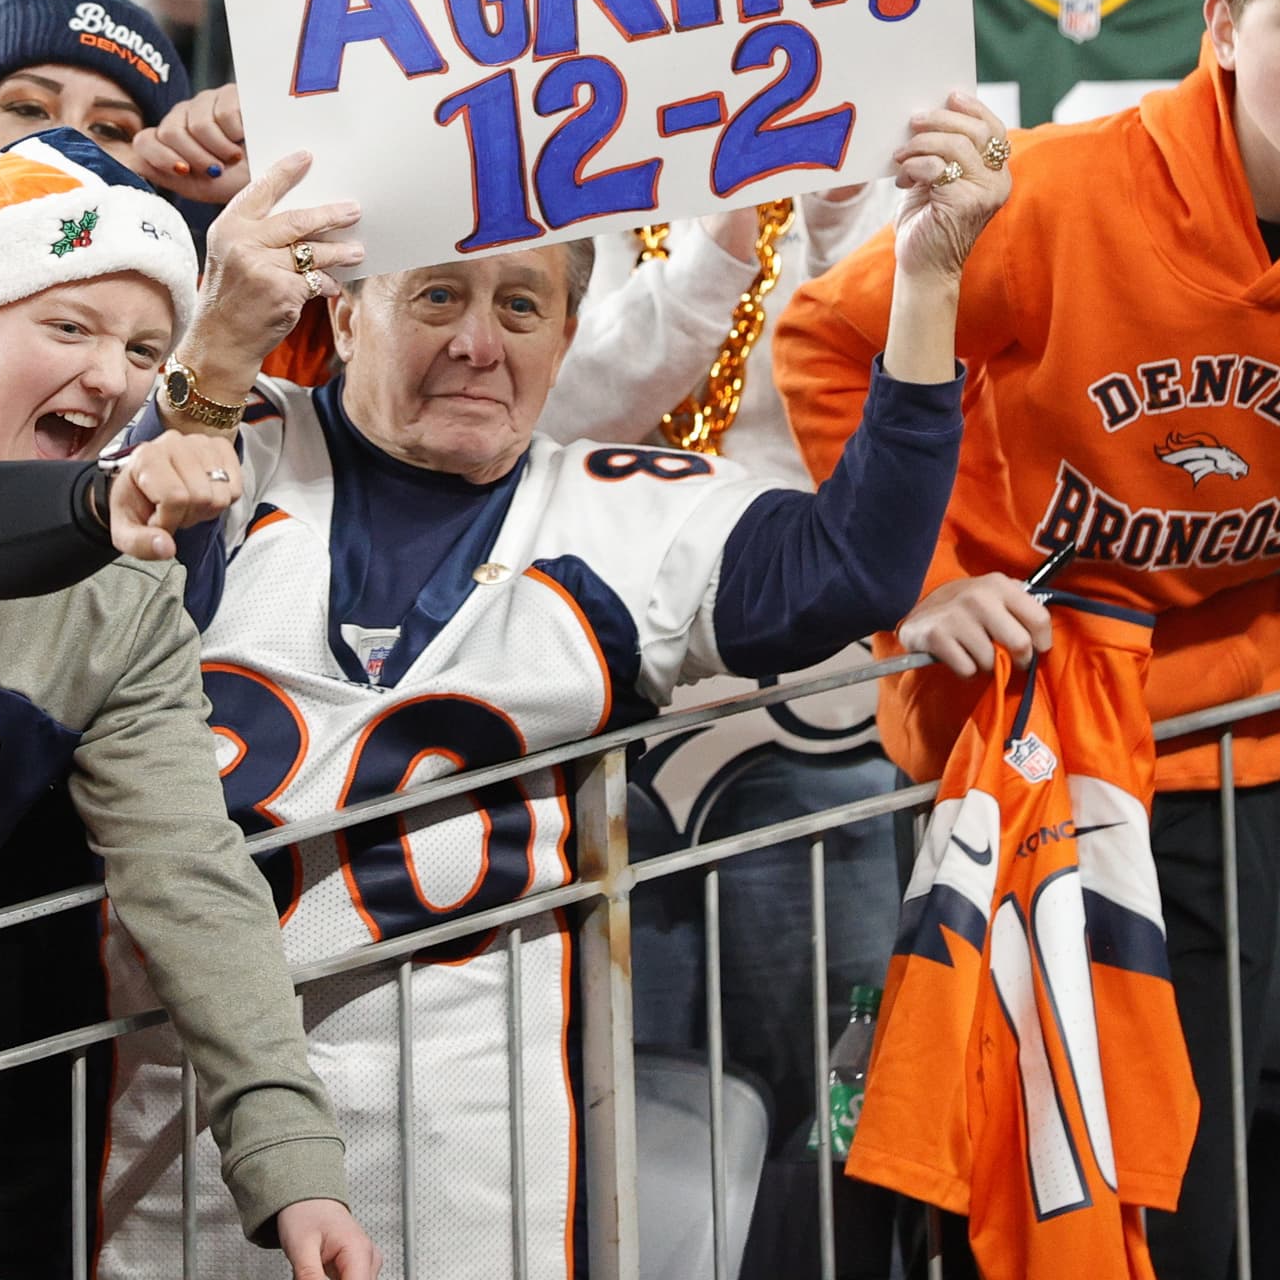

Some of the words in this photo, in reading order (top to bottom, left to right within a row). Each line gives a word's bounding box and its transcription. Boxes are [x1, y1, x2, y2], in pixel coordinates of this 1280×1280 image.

[68, 2, 170, 83] Broncos
[80, 32, 161, 84] DENVER
[434, 20, 856, 253] 12-2
